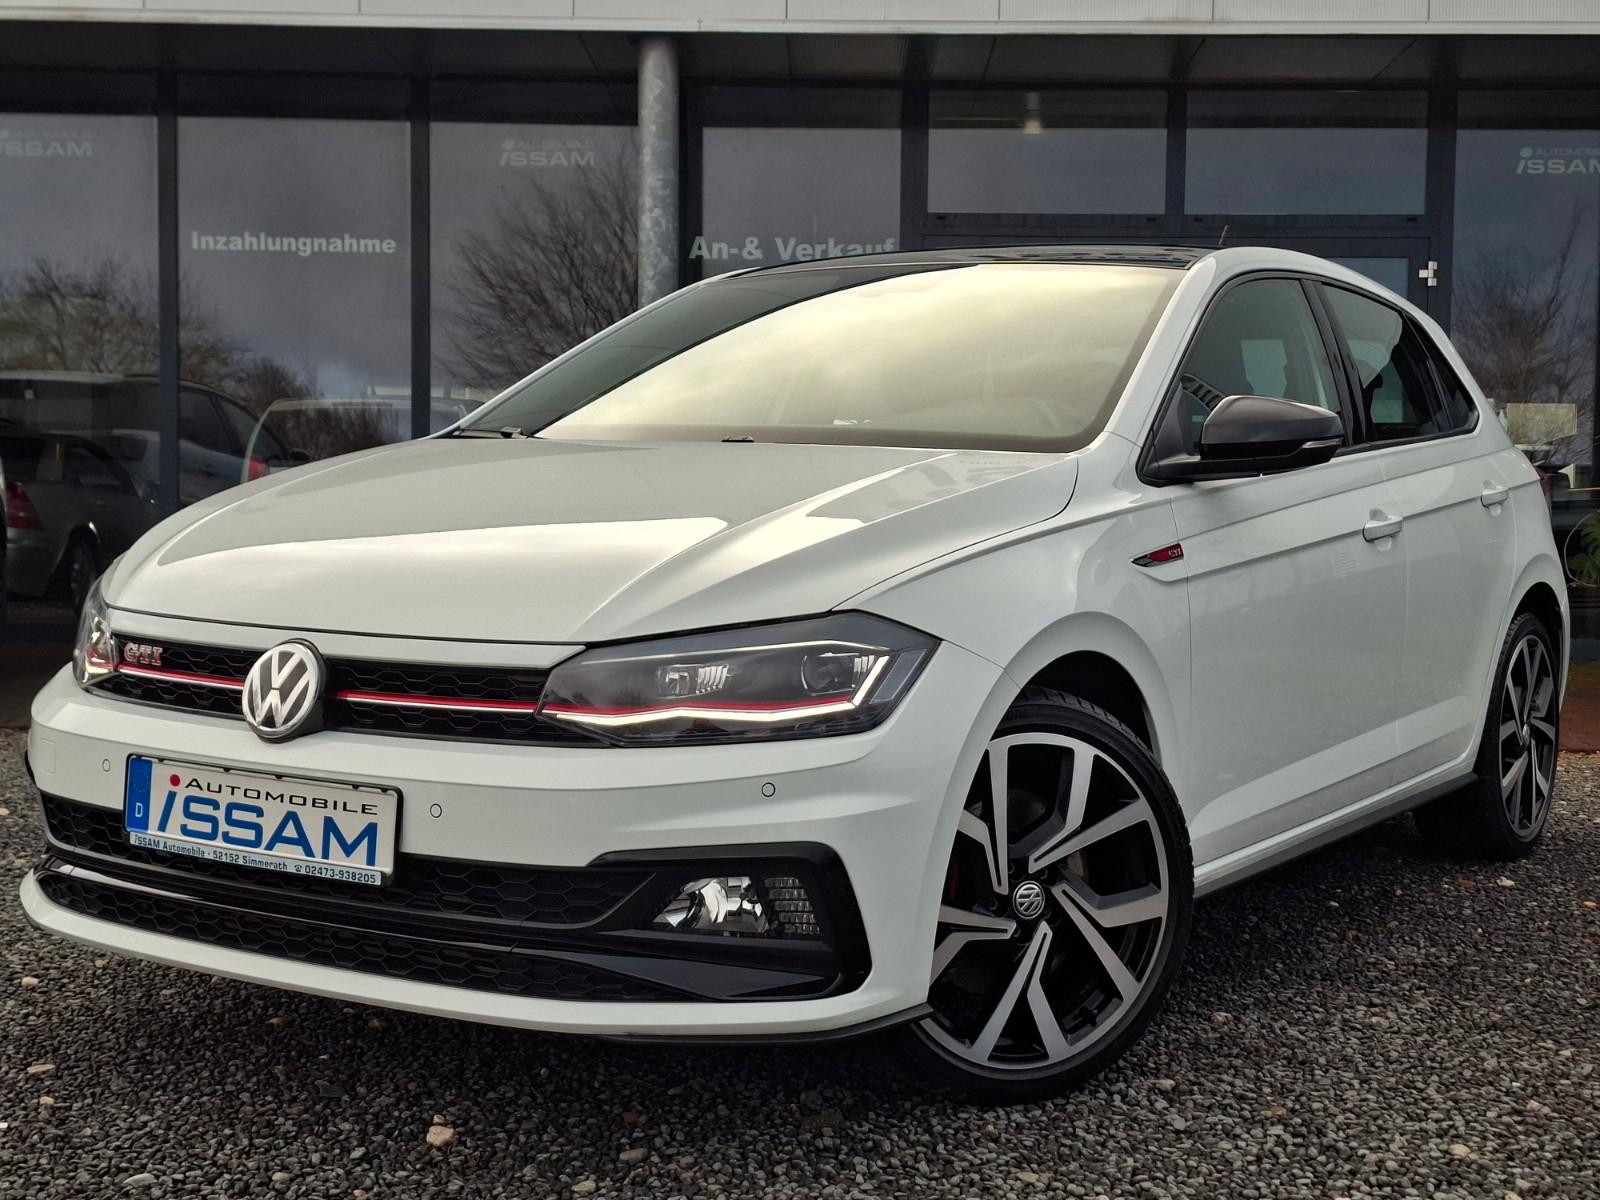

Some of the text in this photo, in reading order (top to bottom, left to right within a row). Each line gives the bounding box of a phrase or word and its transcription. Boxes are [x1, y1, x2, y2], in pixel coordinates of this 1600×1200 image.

[0, 140, 93, 157] SSAM
[192, 231, 397, 255] Inzahlungnahme
[124, 642, 163, 665] GTI
[185, 777, 379, 816] AUTOMOBILE
[135, 802, 143, 818] D
[162, 841, 205, 857] Automobile
[212, 850, 240, 864] 52152
[242, 855, 288, 872] Simmerath
[304, 864, 377, 884] 02473-938205
